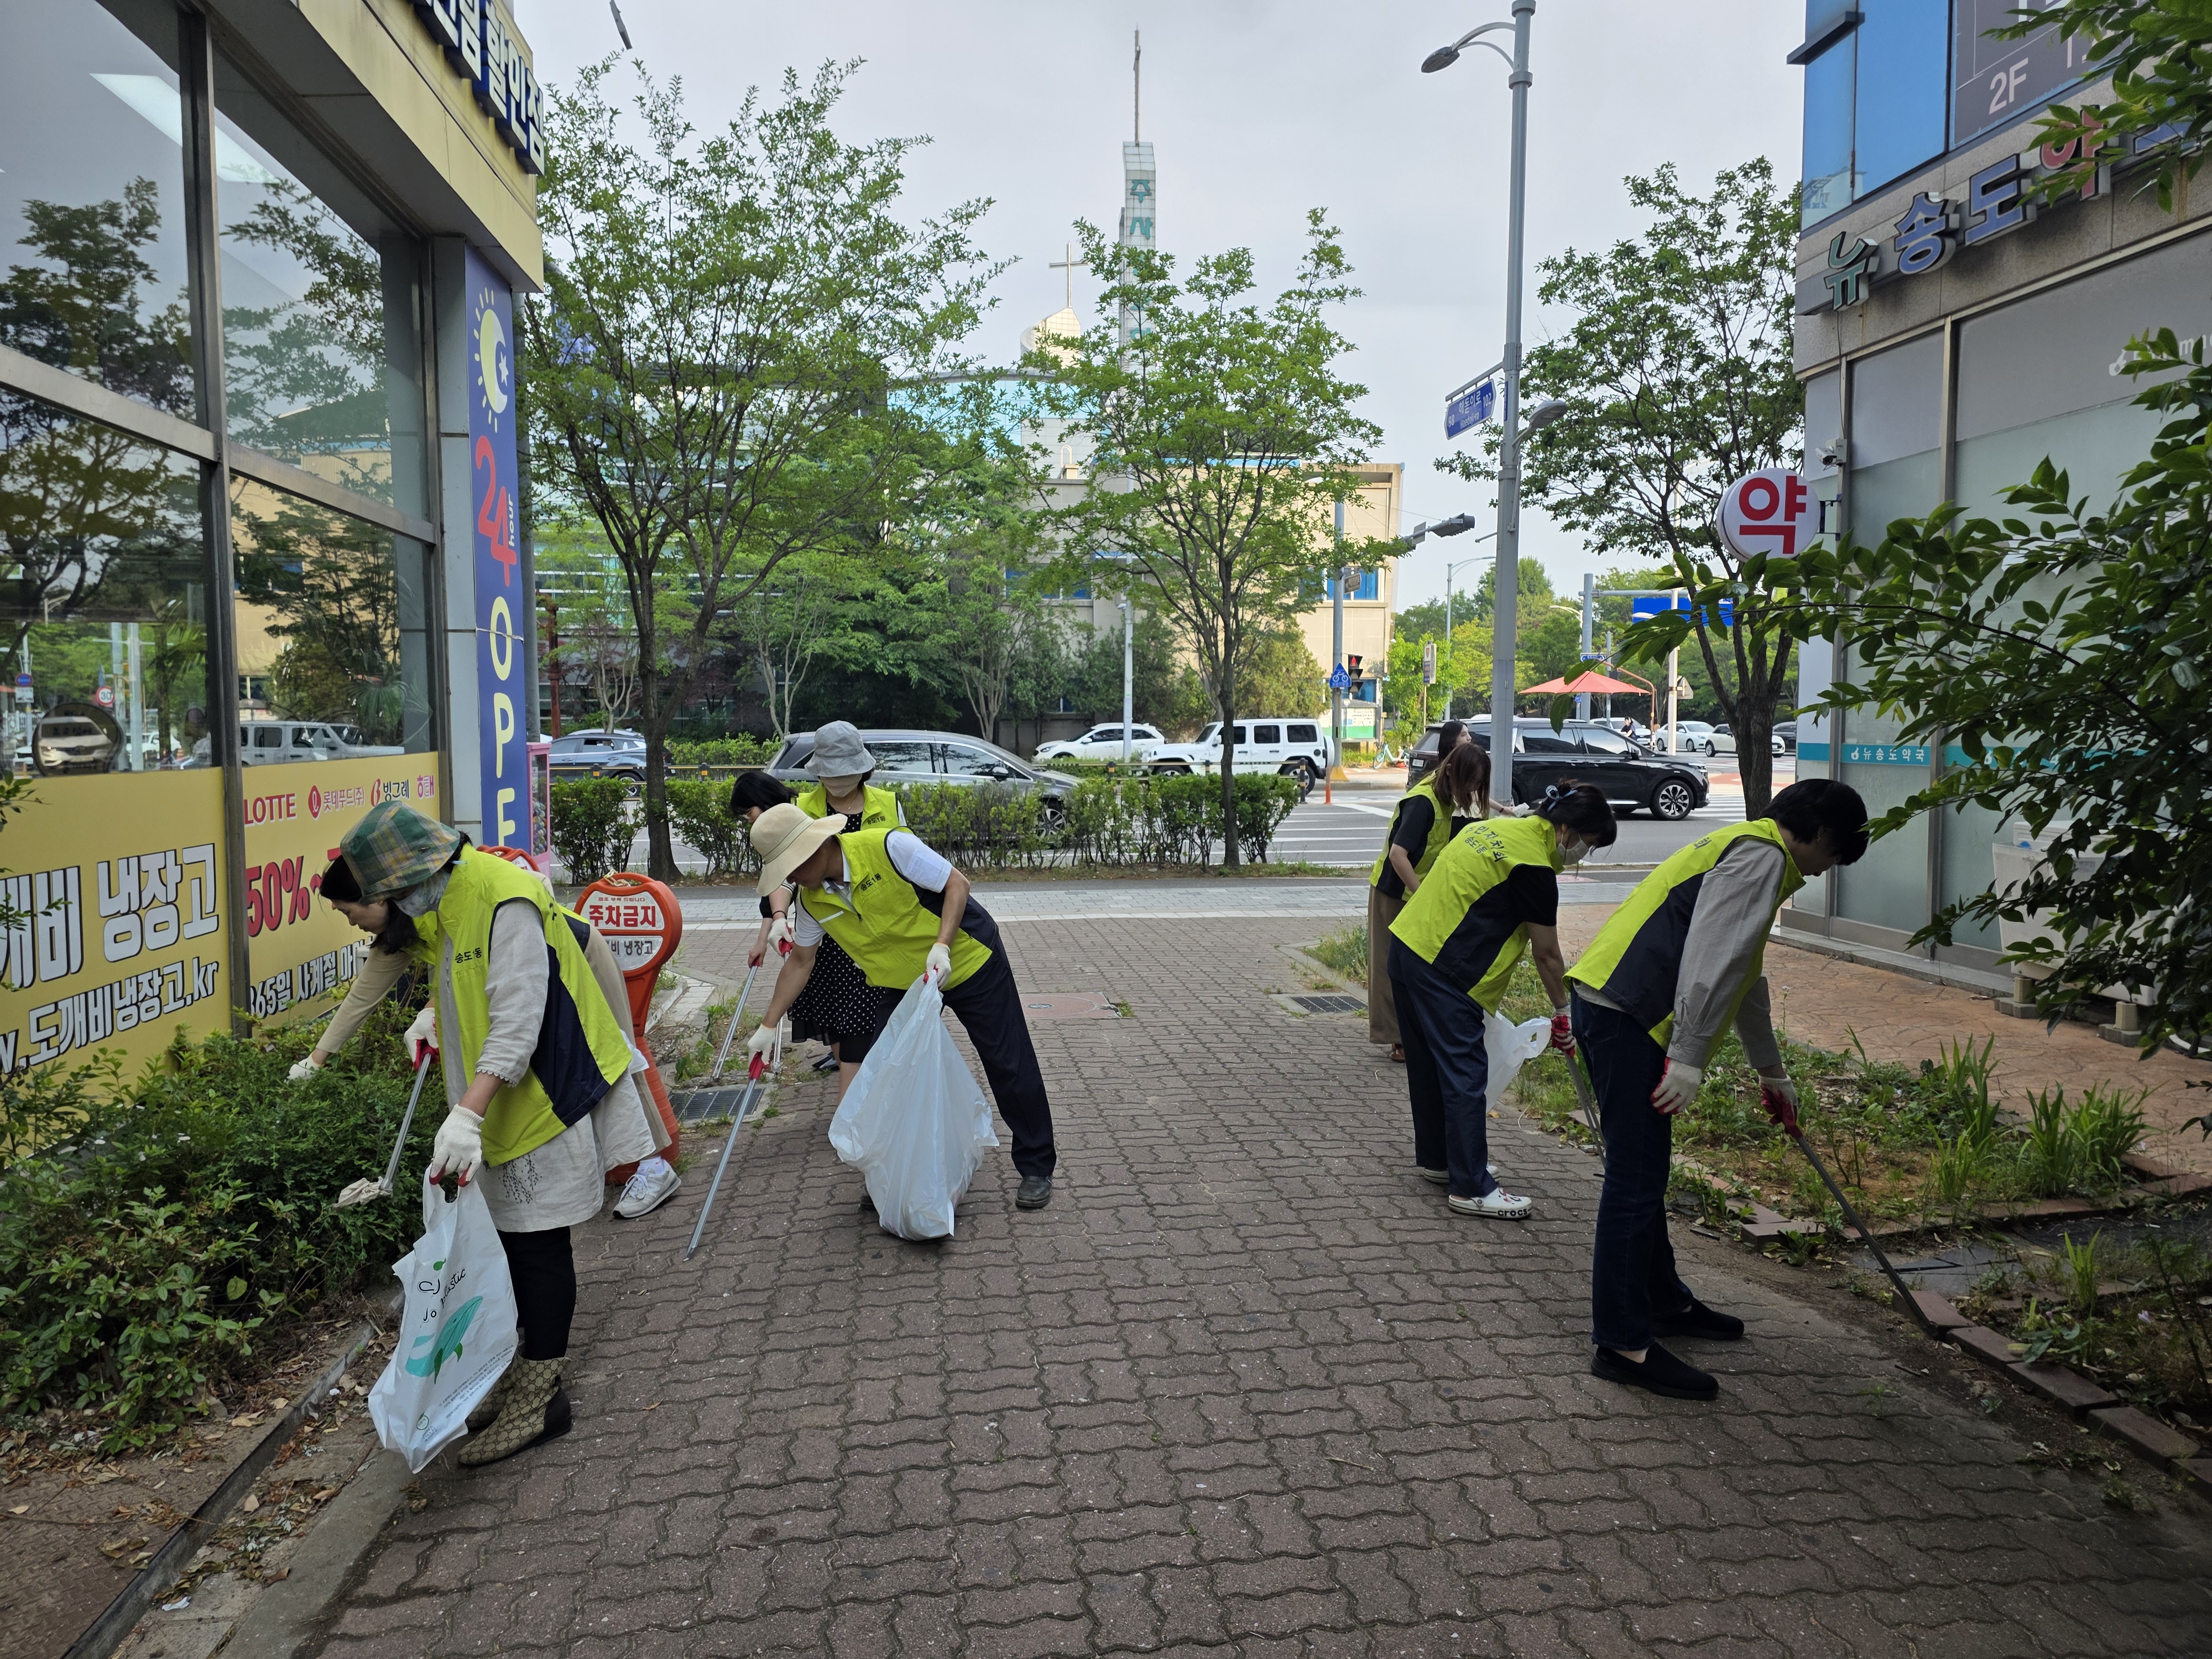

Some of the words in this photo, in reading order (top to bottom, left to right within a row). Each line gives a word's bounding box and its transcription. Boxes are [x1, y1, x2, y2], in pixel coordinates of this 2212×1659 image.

[1989, 58, 2028, 114] 2F
[1483, 392, 1491, 408] 102
[1448, 414, 1455, 428] 98
[476, 435, 517, 587] 24
[1739, 476, 1807, 554] 약
[1863, 747, 1924, 763] 뉴송도약국
[324, 787, 366, 812] 롯데푸드(주)
[383, 779, 409, 802] 빙그레
[243, 793, 297, 825] LOTTE
[867, 816, 886, 825] 송도1동
[1464, 836, 1488, 854] 송도1동
[860, 873, 882, 891] 송도1동
[97, 843, 219, 963] 냉장고
[588, 905, 656, 927] 주차금지
[608, 941, 620, 955] 비
[624, 940, 654, 956] 냉장고
[296, 950, 338, 1003] 사계절
[1497, 1208, 1527, 1217] crocs
